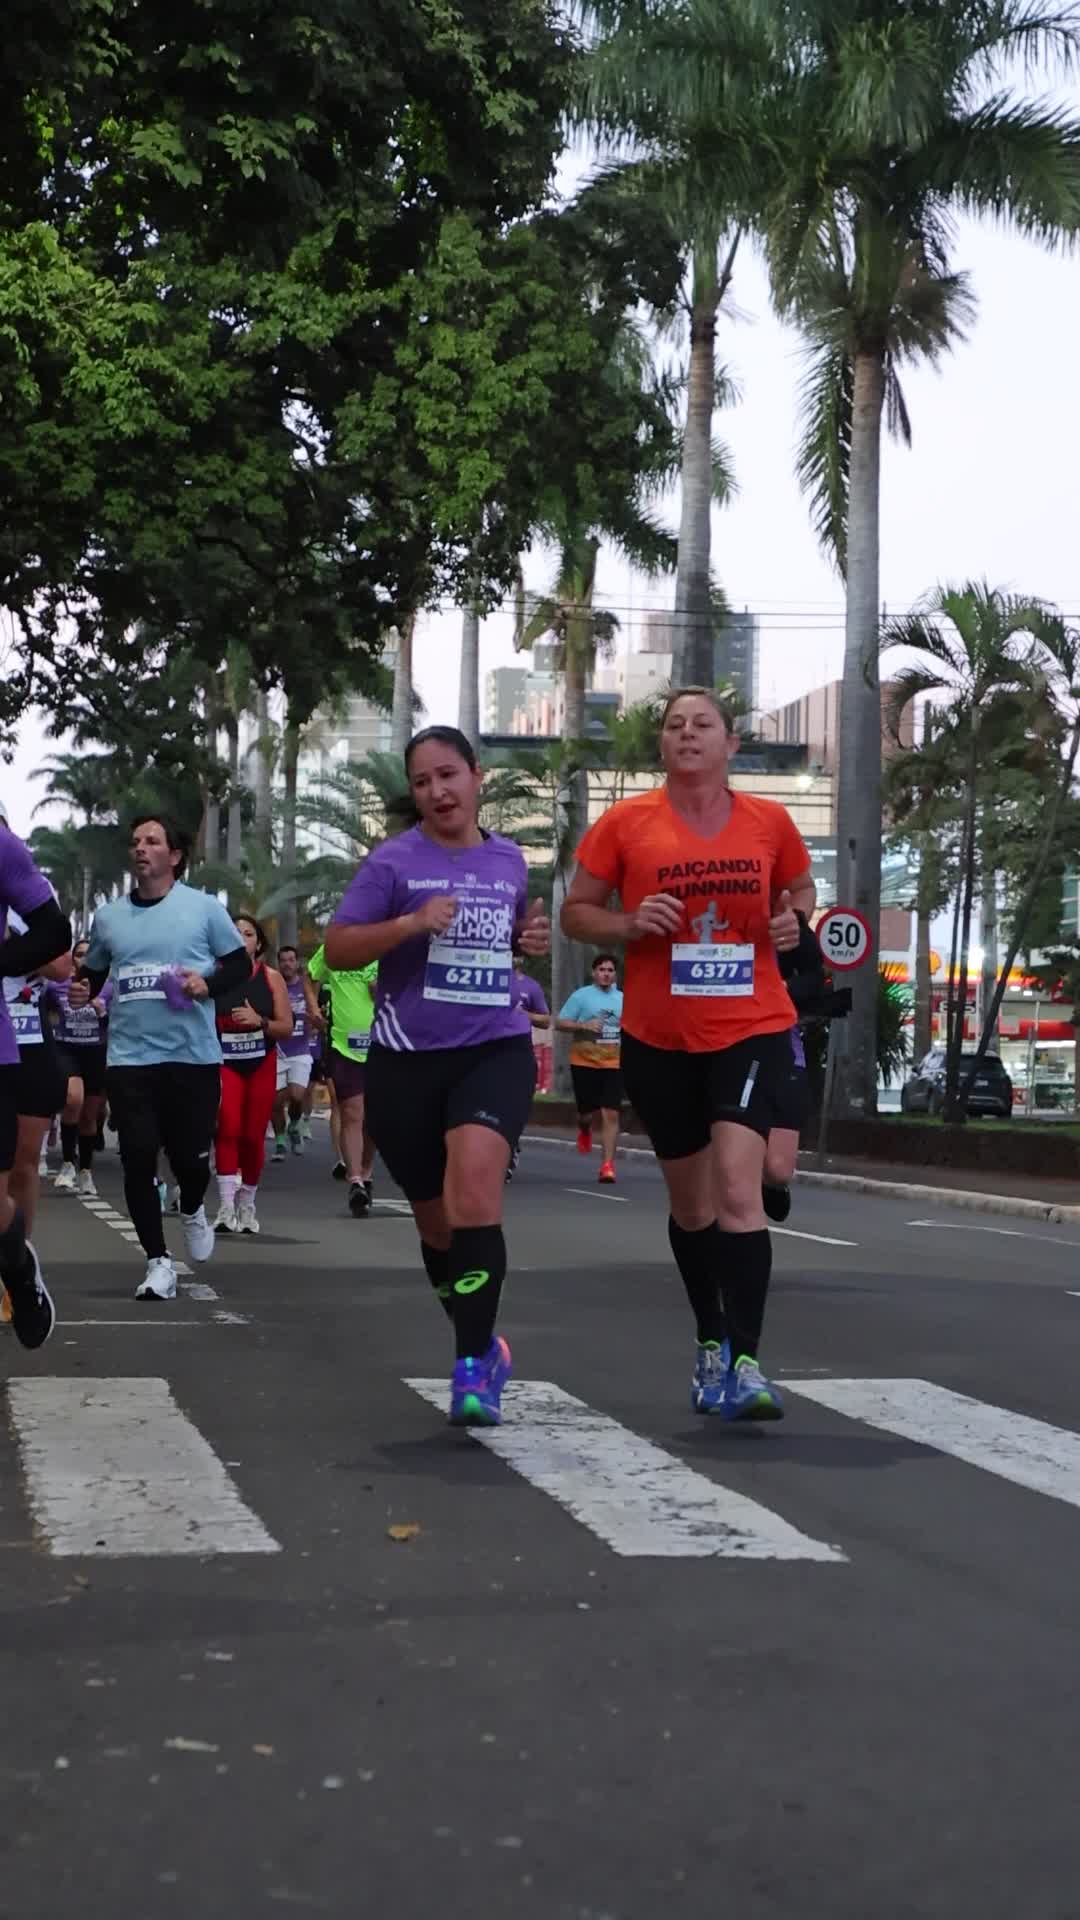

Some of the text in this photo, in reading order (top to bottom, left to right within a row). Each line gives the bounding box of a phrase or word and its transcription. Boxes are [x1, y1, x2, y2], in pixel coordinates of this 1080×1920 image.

[658, 859, 761, 884] PAIÇANDU
[828, 921, 860, 948] 50
[445, 967, 494, 986] 6211
[690, 962, 739, 978] 6377
[128, 976, 158, 989] 5637
